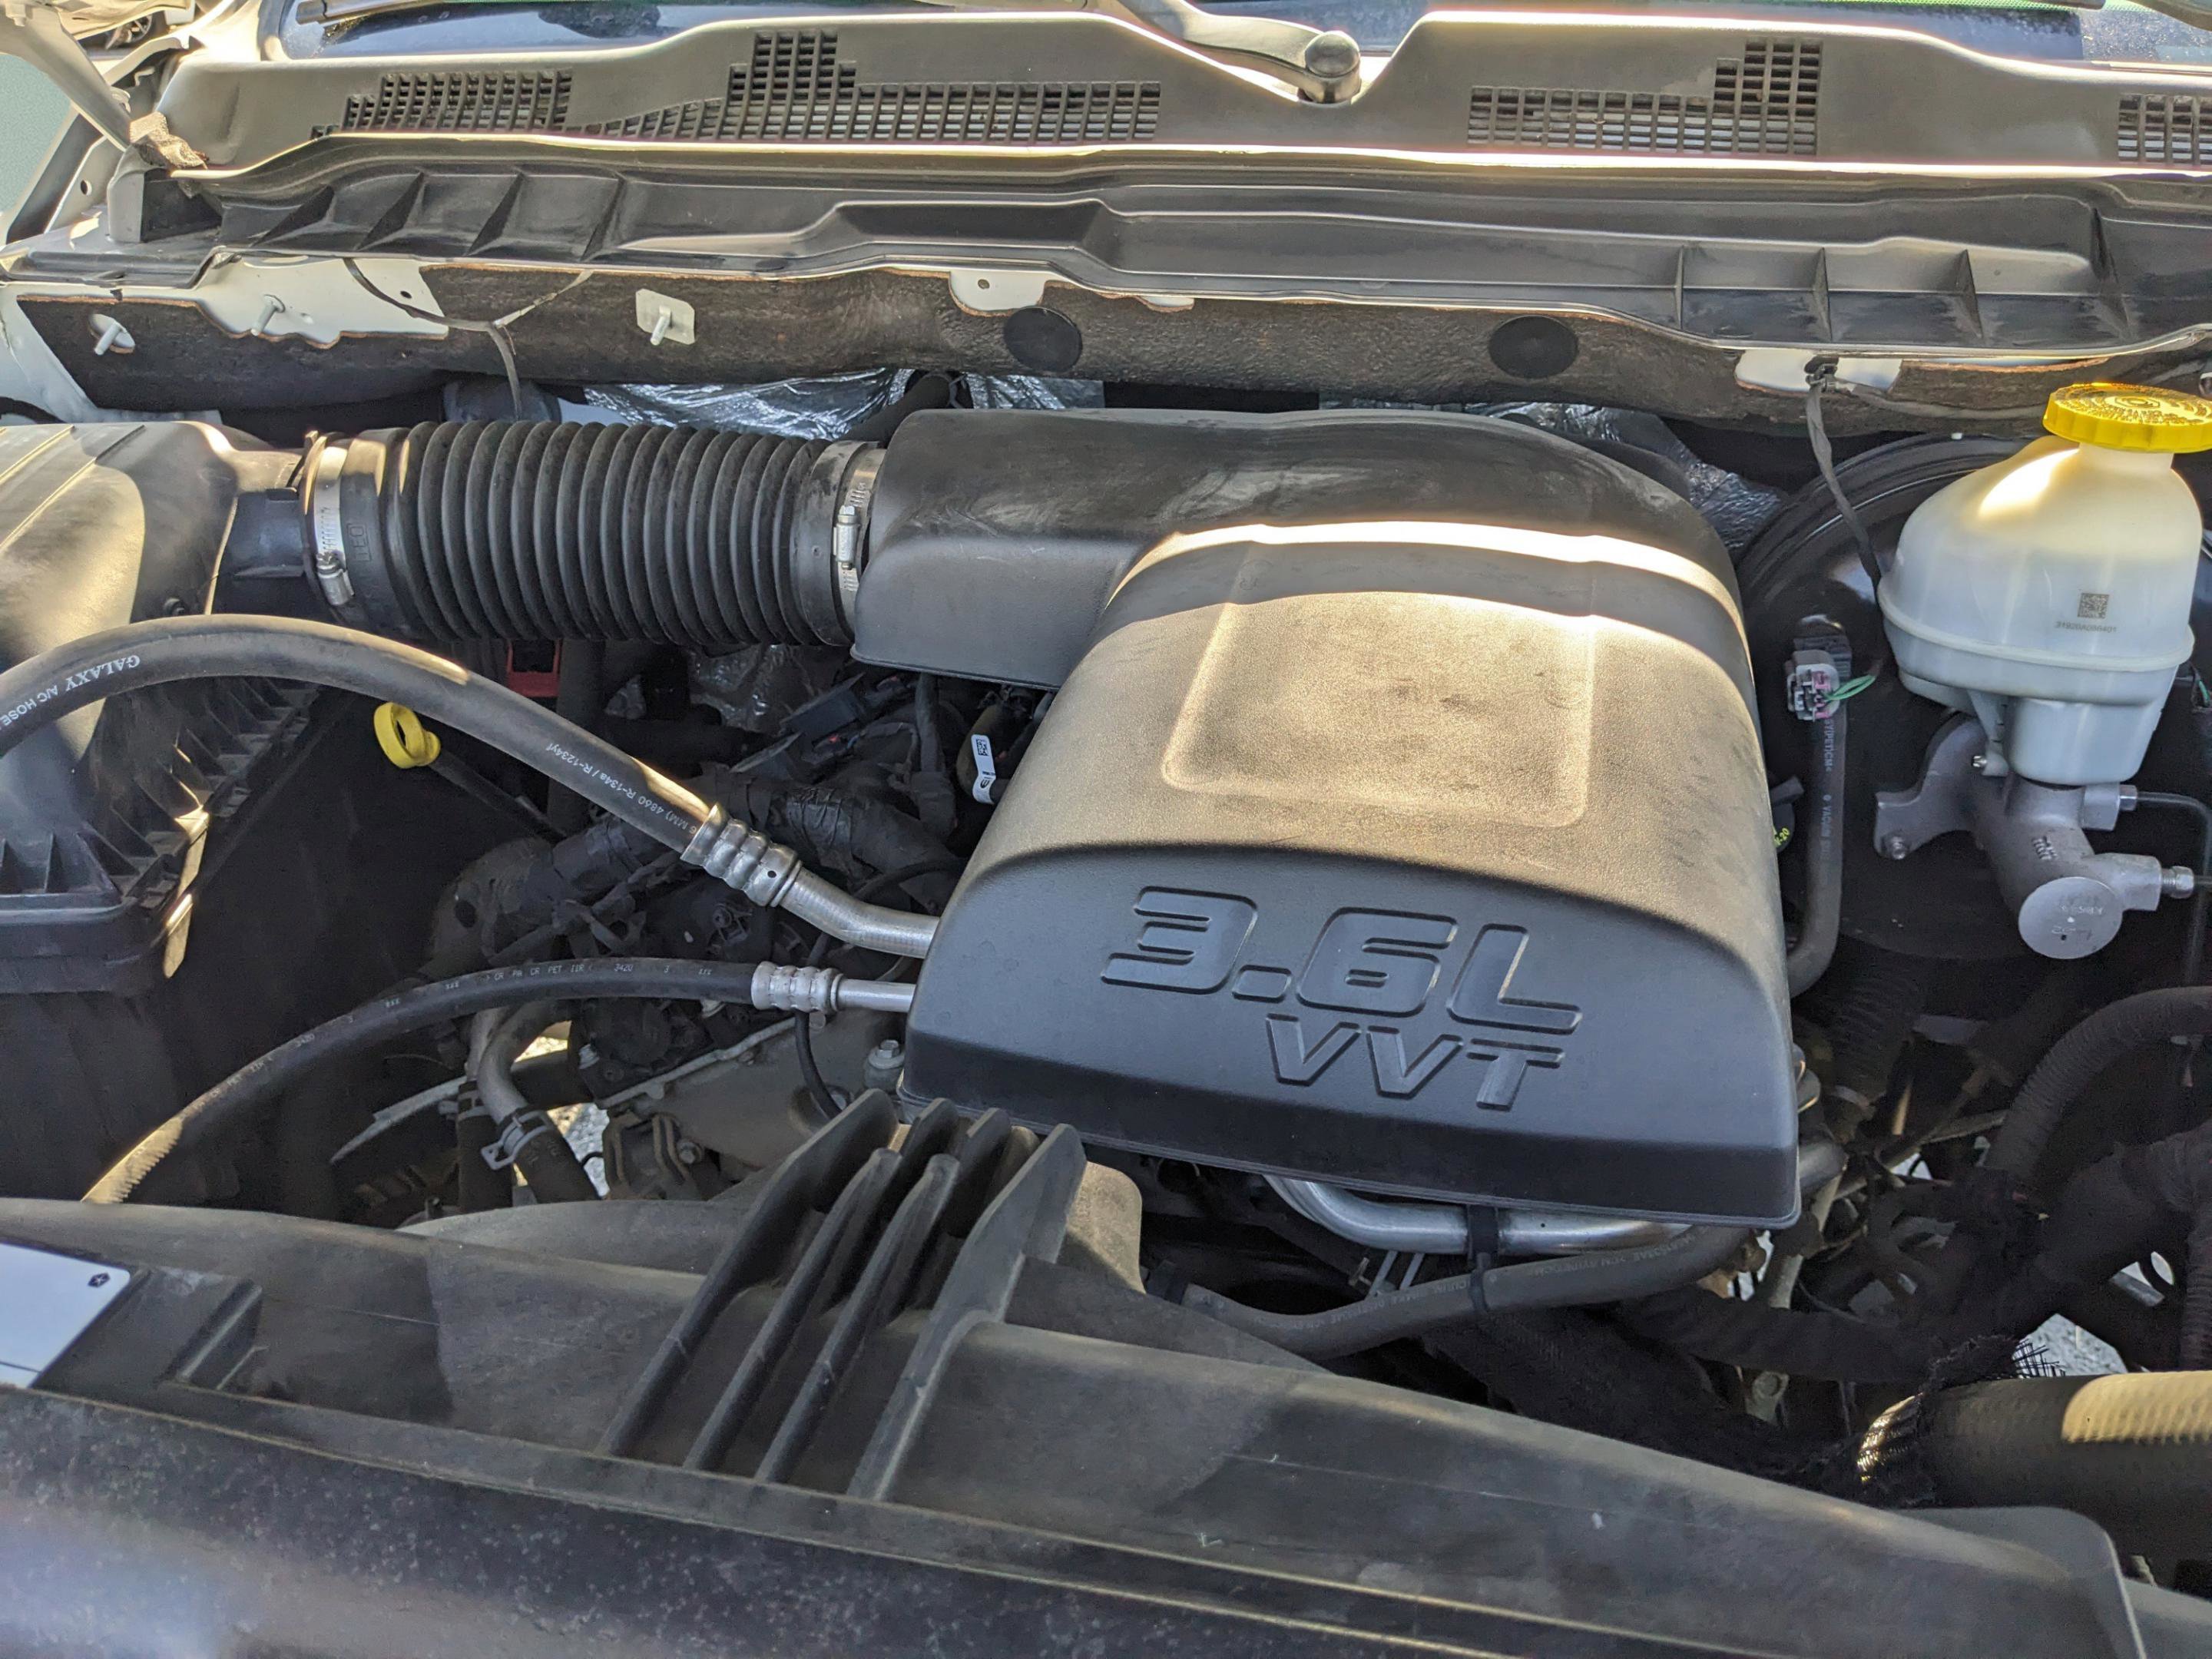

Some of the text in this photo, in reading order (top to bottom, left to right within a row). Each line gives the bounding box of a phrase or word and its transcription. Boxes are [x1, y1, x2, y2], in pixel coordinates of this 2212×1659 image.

[0, 654, 141, 726] GALAXY A/C HOSE
[546, 743, 594, 774] R-1234yf
[600, 773, 637, 800] R-134a
[637, 795, 664, 815] 4860
[665, 810, 689, 830] MM)
[548, 965, 562, 974] PET
[1101, 885, 1583, 1035] 3.6L
[1266, 1012, 1566, 1113] VVT
